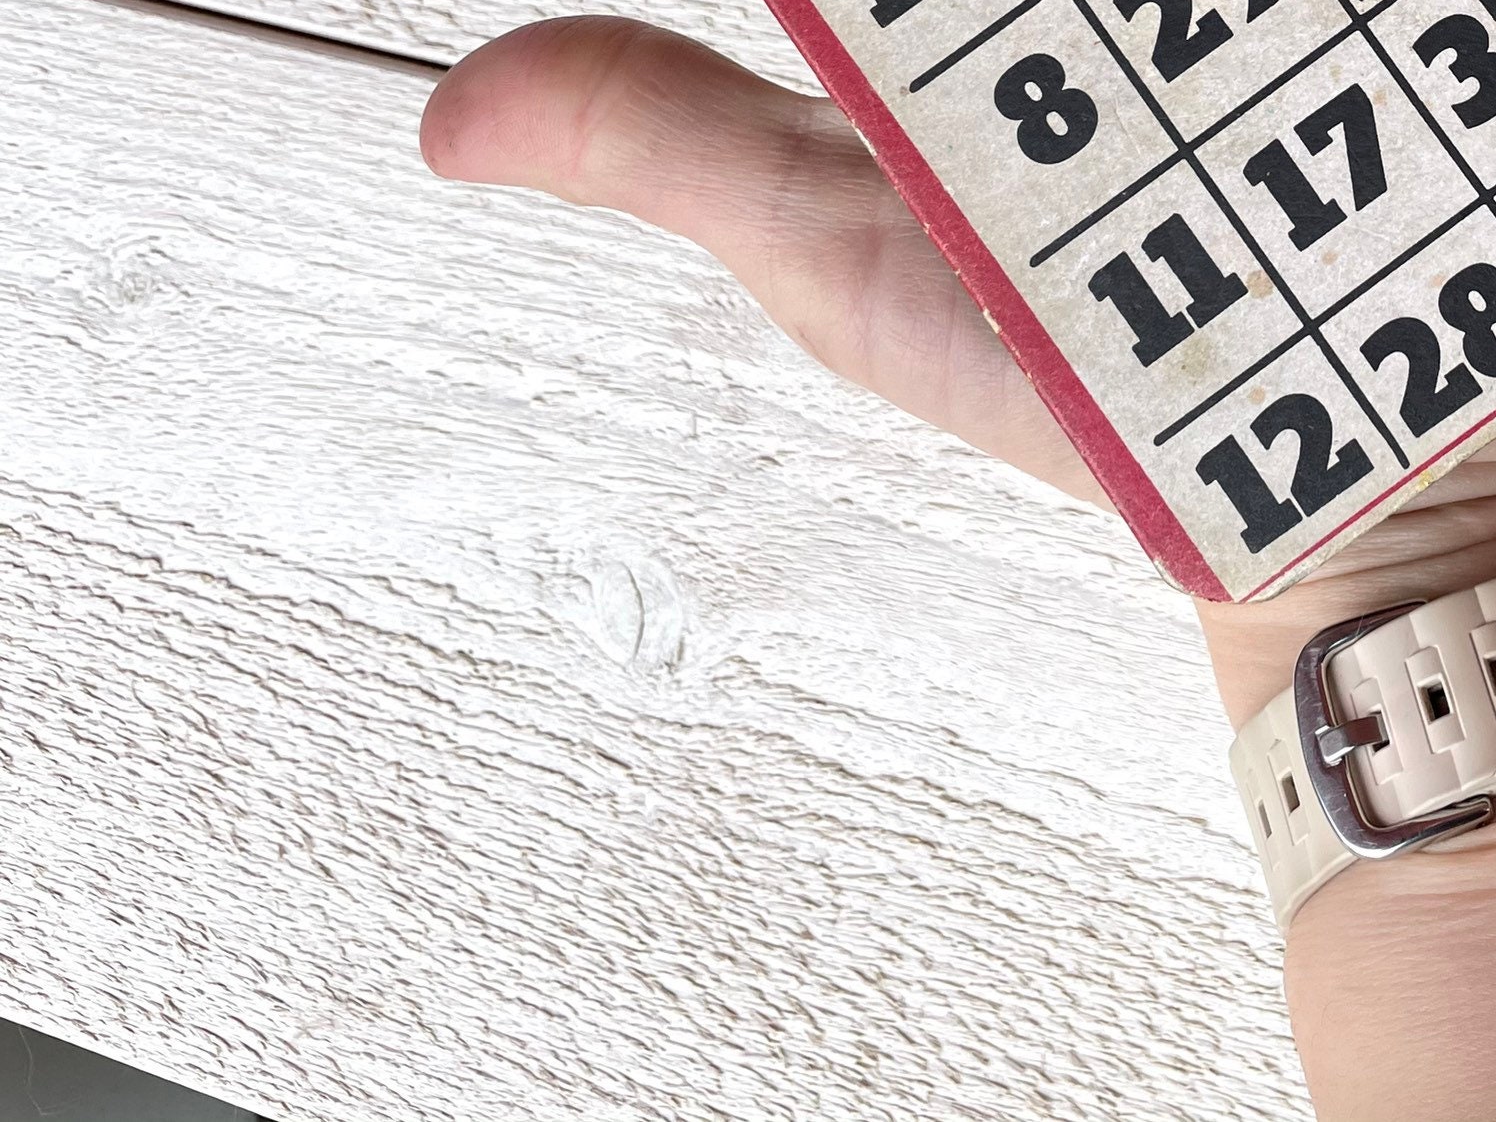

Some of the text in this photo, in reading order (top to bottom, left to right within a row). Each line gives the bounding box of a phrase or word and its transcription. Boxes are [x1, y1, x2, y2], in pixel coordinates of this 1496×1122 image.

[994, 54, 1098, 164] 8
[1088, 214, 1248, 367] 11
[1243, 84, 1387, 251] 17
[1196, 394, 1374, 553] 12
